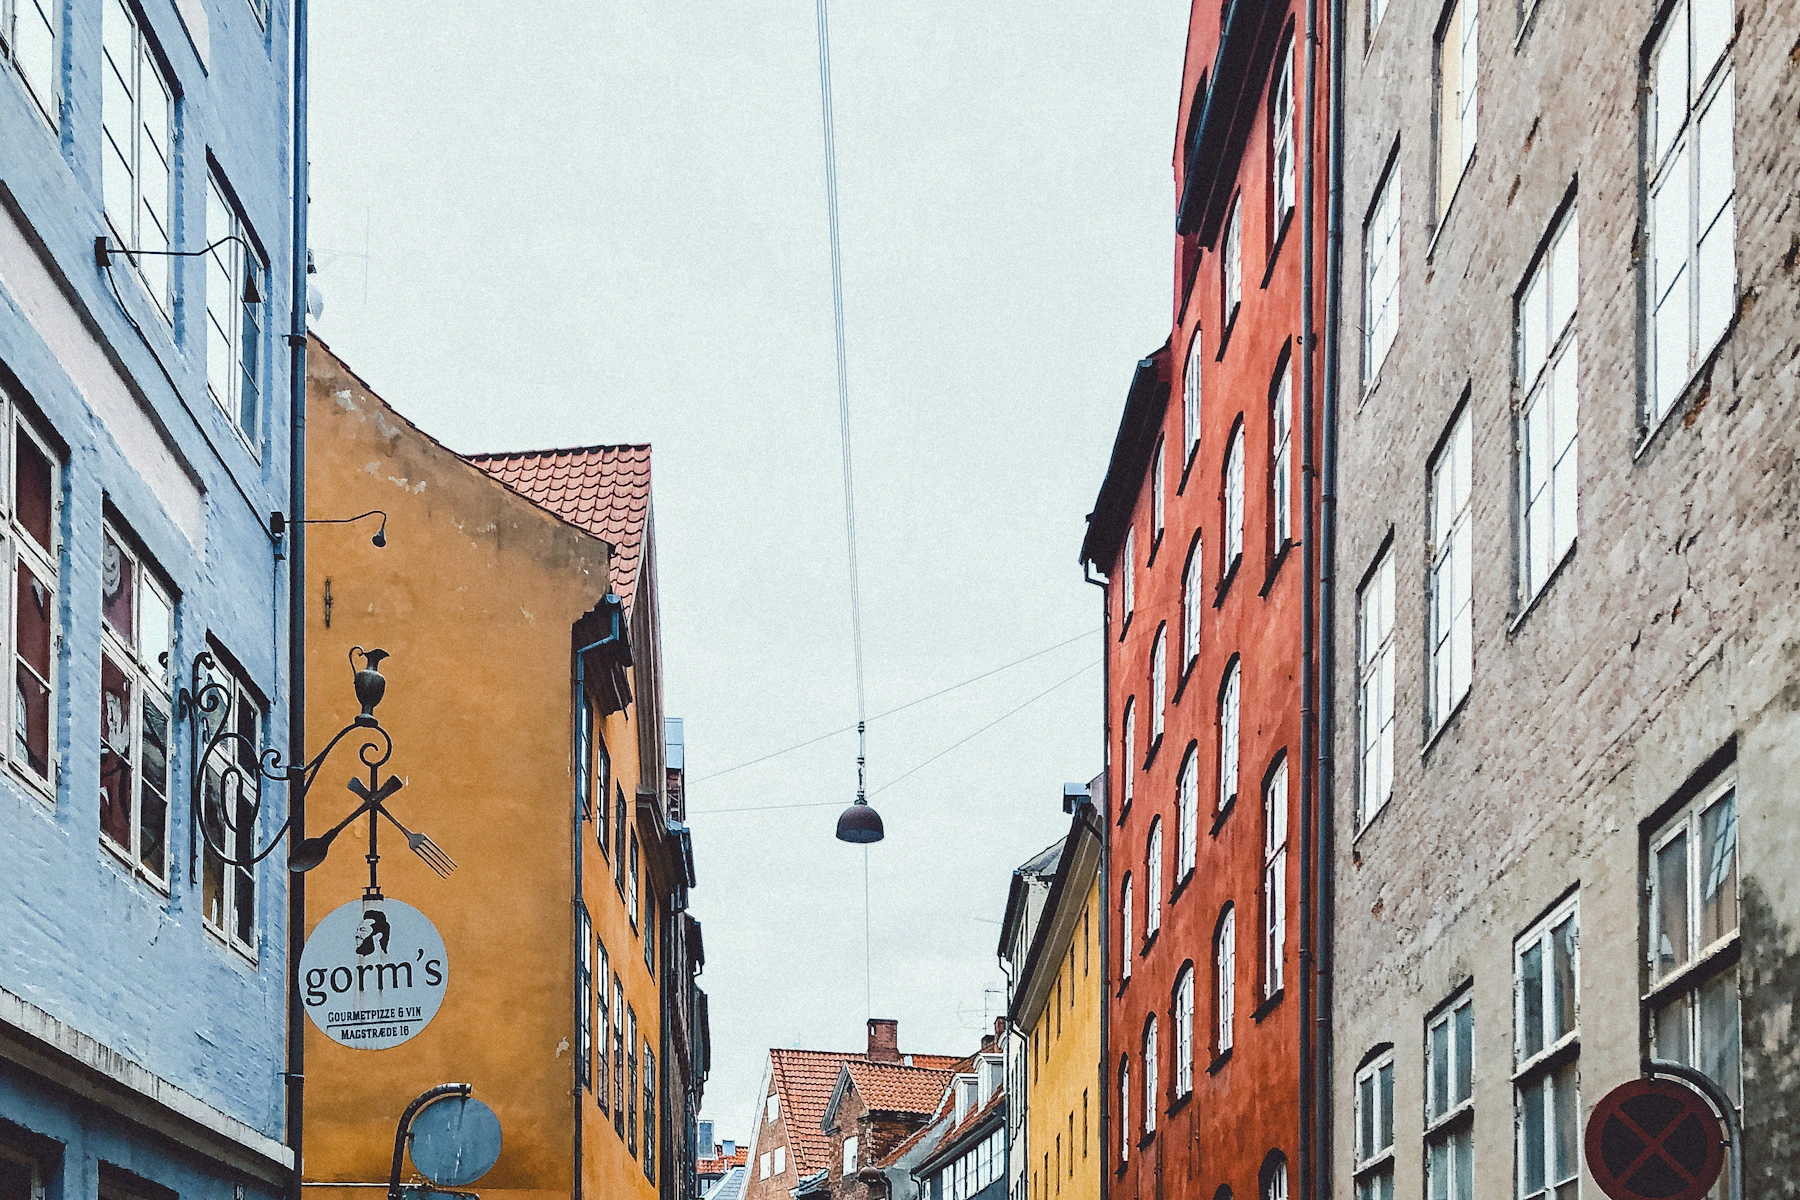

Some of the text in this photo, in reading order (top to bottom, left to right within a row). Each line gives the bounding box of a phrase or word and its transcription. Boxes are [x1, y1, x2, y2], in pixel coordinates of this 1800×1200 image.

[305, 948, 443, 1007] gorm's
[327, 1008, 396, 1022] GOURMETPIZZE
[406, 1006, 421, 1017] VIN
[341, 1027, 398, 1040] MAGSTRÆDE
